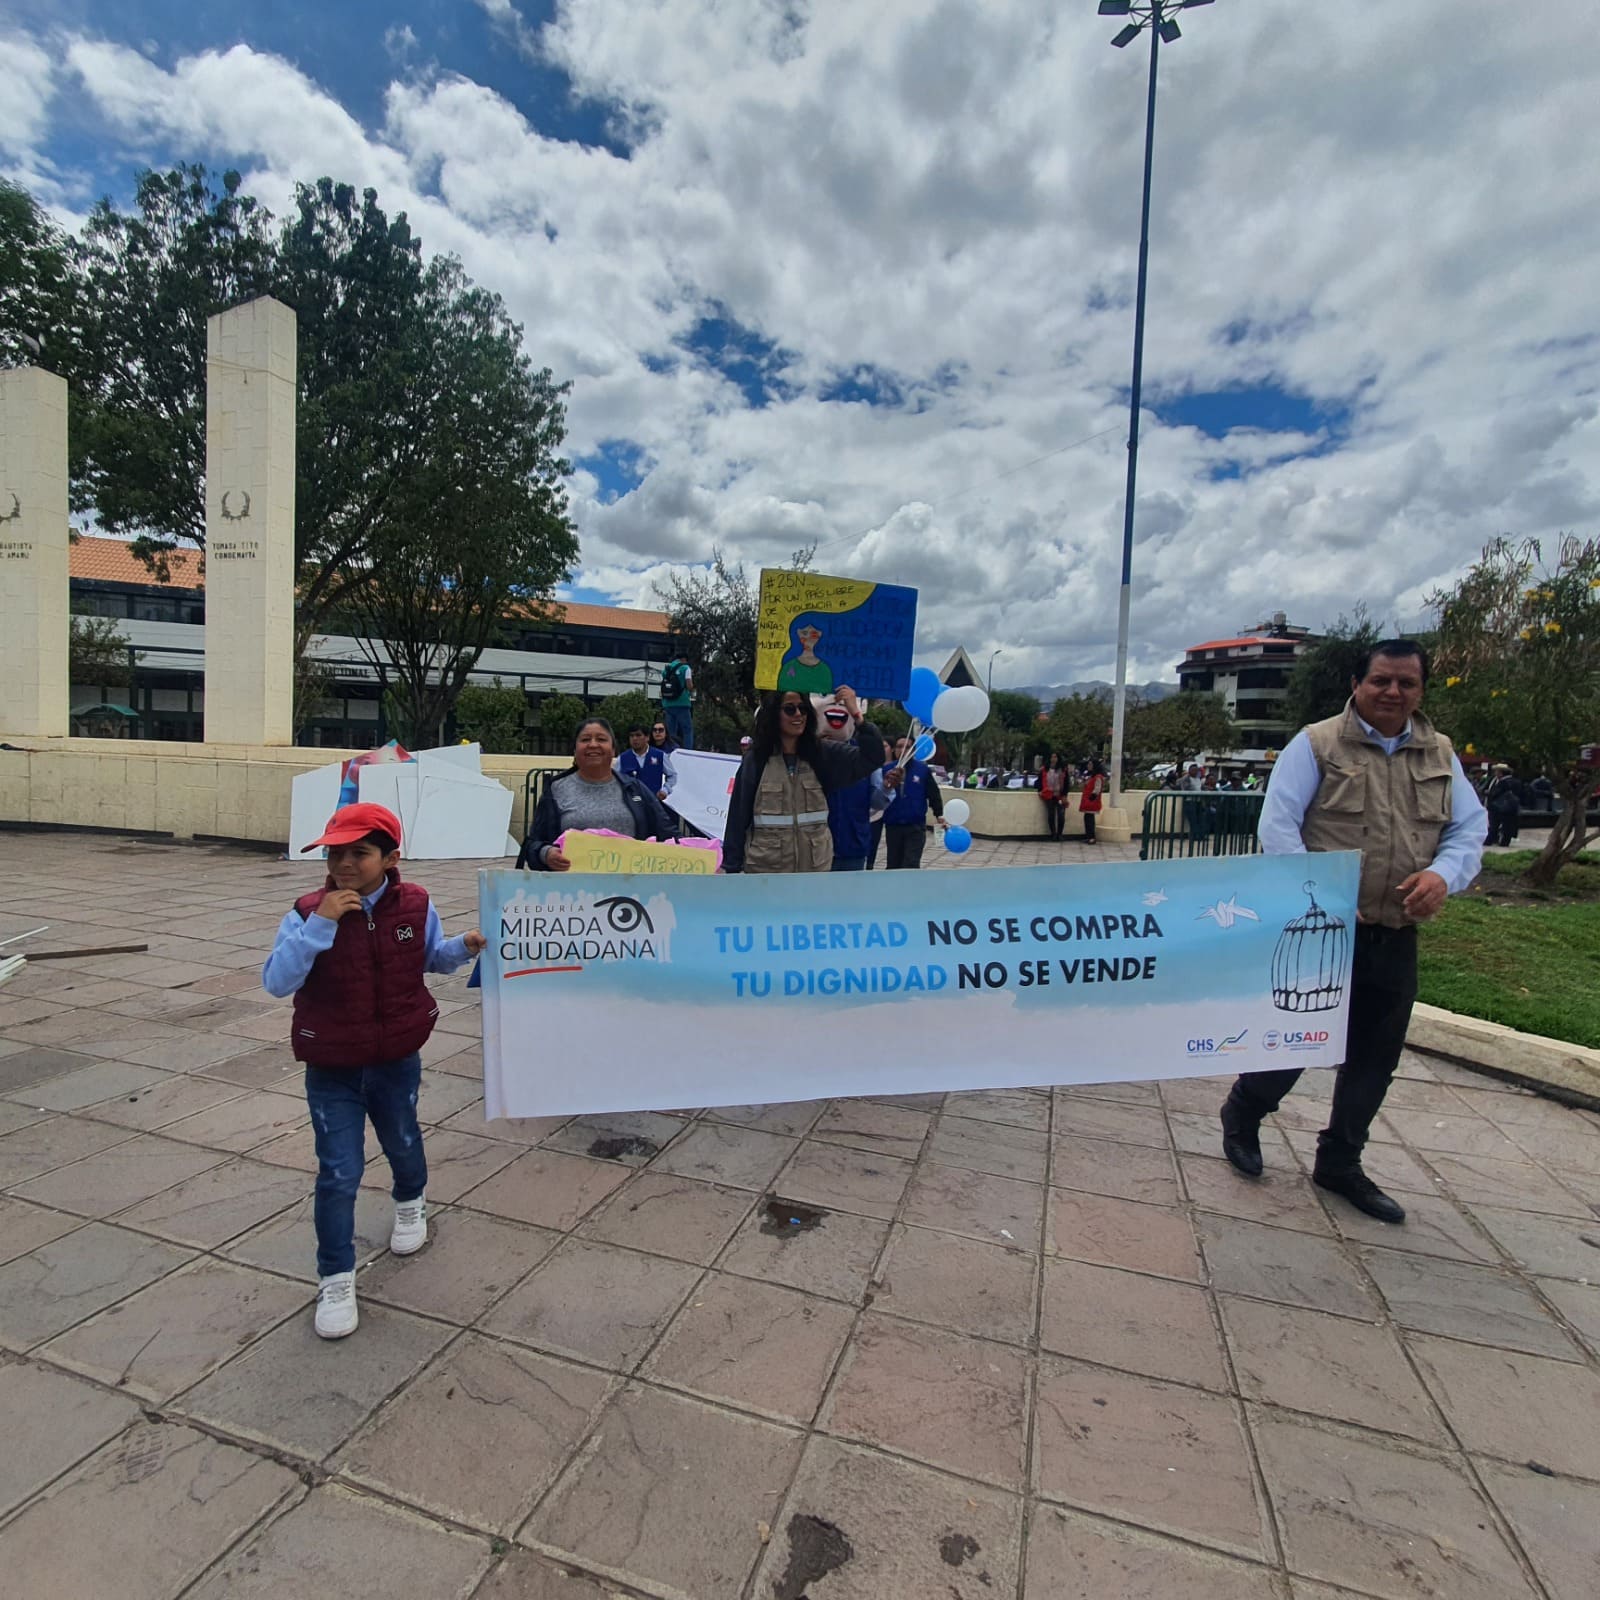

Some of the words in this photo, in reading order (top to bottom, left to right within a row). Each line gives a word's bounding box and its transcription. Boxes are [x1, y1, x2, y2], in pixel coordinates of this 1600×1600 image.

[502, 904, 585, 914] VEEDURÍA
[500, 917, 603, 938] MIRADA
[714, 926, 754, 953] TU
[766, 921, 908, 951] LIBERTAD
[927, 919, 978, 946] NO
[988, 917, 1021, 944] SE
[1030, 914, 1163, 942] COMPRA
[500, 939, 656, 961] CIUDADANA
[731, 971, 771, 997] TU
[784, 964, 947, 996] DIGNIDAD
[958, 961, 1008, 989] NO
[1018, 960, 1050, 987] SE
[1059, 956, 1157, 984] VENDE
[1187, 1039, 1214, 1052] CHS
[1283, 1031, 1329, 1044] USAID
